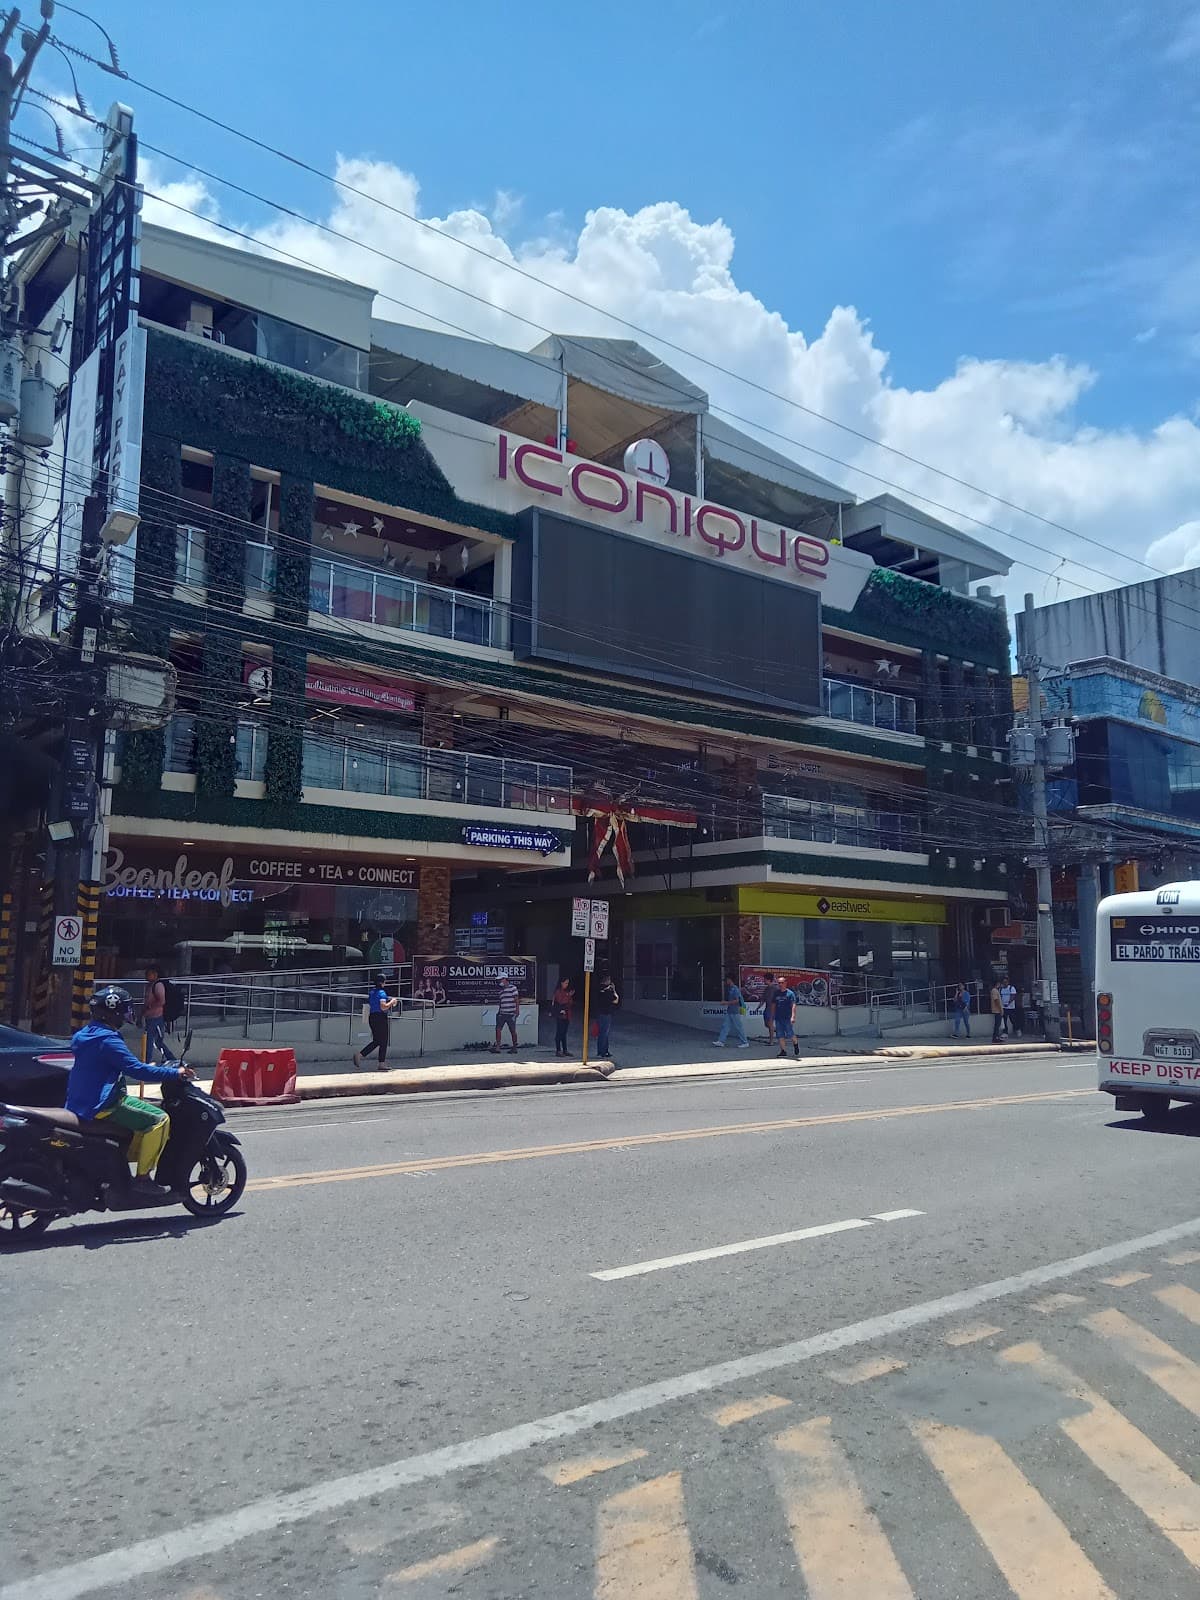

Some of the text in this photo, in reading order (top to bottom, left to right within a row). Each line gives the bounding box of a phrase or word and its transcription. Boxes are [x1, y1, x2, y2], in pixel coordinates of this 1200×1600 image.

[470, 832, 553, 848] PARKING THIS WAY
[100, 846, 236, 908] Beanleaf
[249, 860, 415, 884] COFFEE TEA CONNECT
[831, 900, 872, 914] eastwest
[1156, 926, 1200, 934] HINO
[59, 946, 75, 955] NO
[1118, 945, 1130, 958] EL
[1133, 945, 1165, 958] PARDO
[448, 966, 483, 977] SALON
[1110, 1061, 1152, 1076] KEEP
